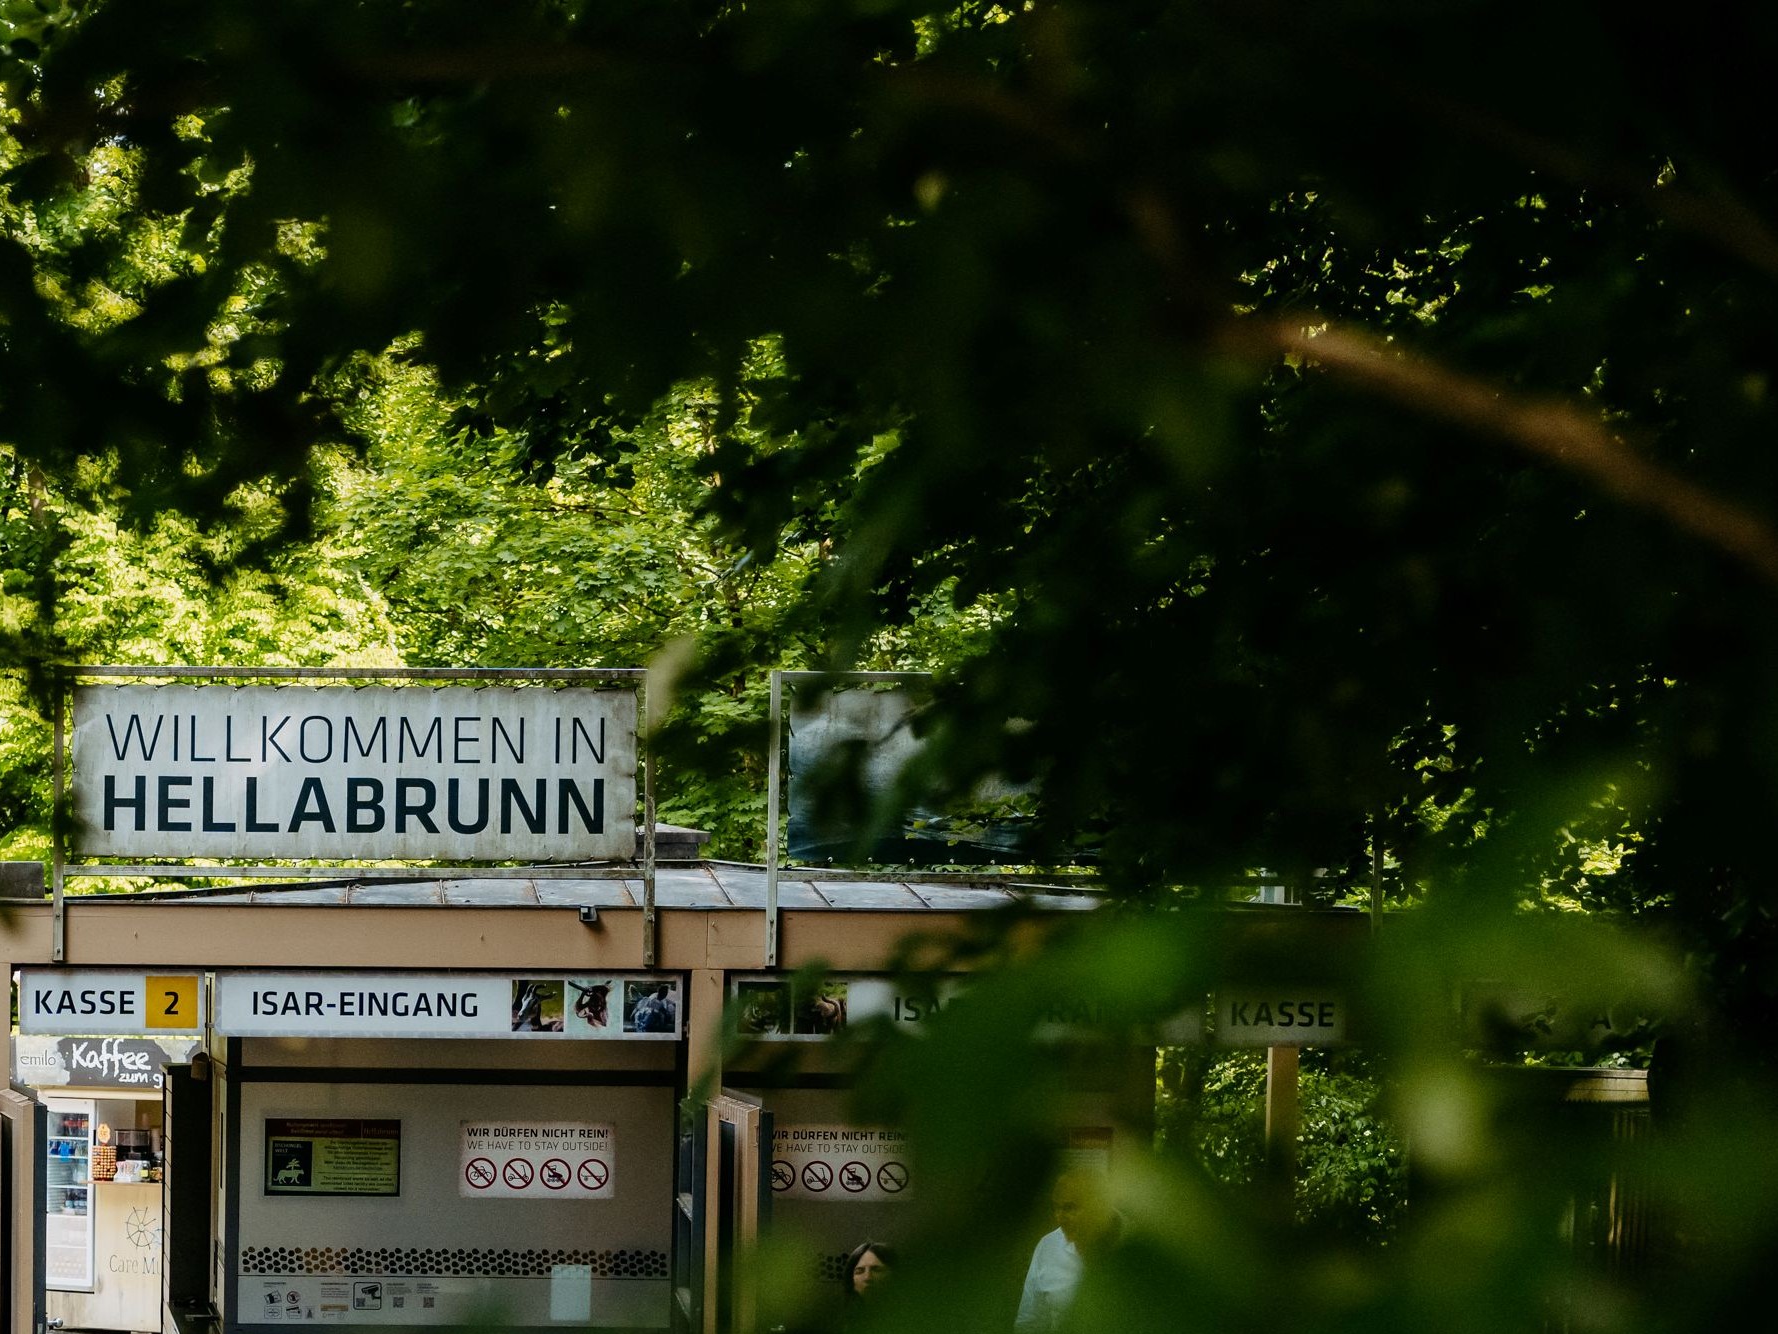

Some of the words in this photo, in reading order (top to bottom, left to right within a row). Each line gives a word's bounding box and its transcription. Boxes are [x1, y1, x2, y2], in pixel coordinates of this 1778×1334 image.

[106, 713, 524, 764] WILLKOMMEN
[554, 715, 606, 765] IN
[103, 774, 605, 836] HELLABRUNN
[34, 989, 135, 1015] KASSE
[164, 991, 179, 1015] 2
[252, 991, 479, 1017] ISAR-EINGANG
[1231, 1001, 1335, 1027] KASSE
[20, 1049, 56, 1066] emilo
[72, 1038, 152, 1078] Kaffee
[467, 1128, 490, 1137] WIR
[493, 1127, 538, 1138] DÜRFEN
[542, 1128, 575, 1138] NICHT
[578, 1129, 608, 1138] REIN!
[793, 1129, 838, 1141] DÜRFEN
[841, 1131, 874, 1141] NICHT
[467, 1141, 484, 1150] WE
[487, 1141, 515, 1150] HAVE
[518, 1141, 531, 1150] TO
[534, 1141, 560, 1151] STAY
[562, 1141, 608, 1151] OUTSIDE!
[786, 1143, 814, 1153] HAVE
[816, 1143, 830, 1153] TO
[833, 1143, 859, 1153] STAY
